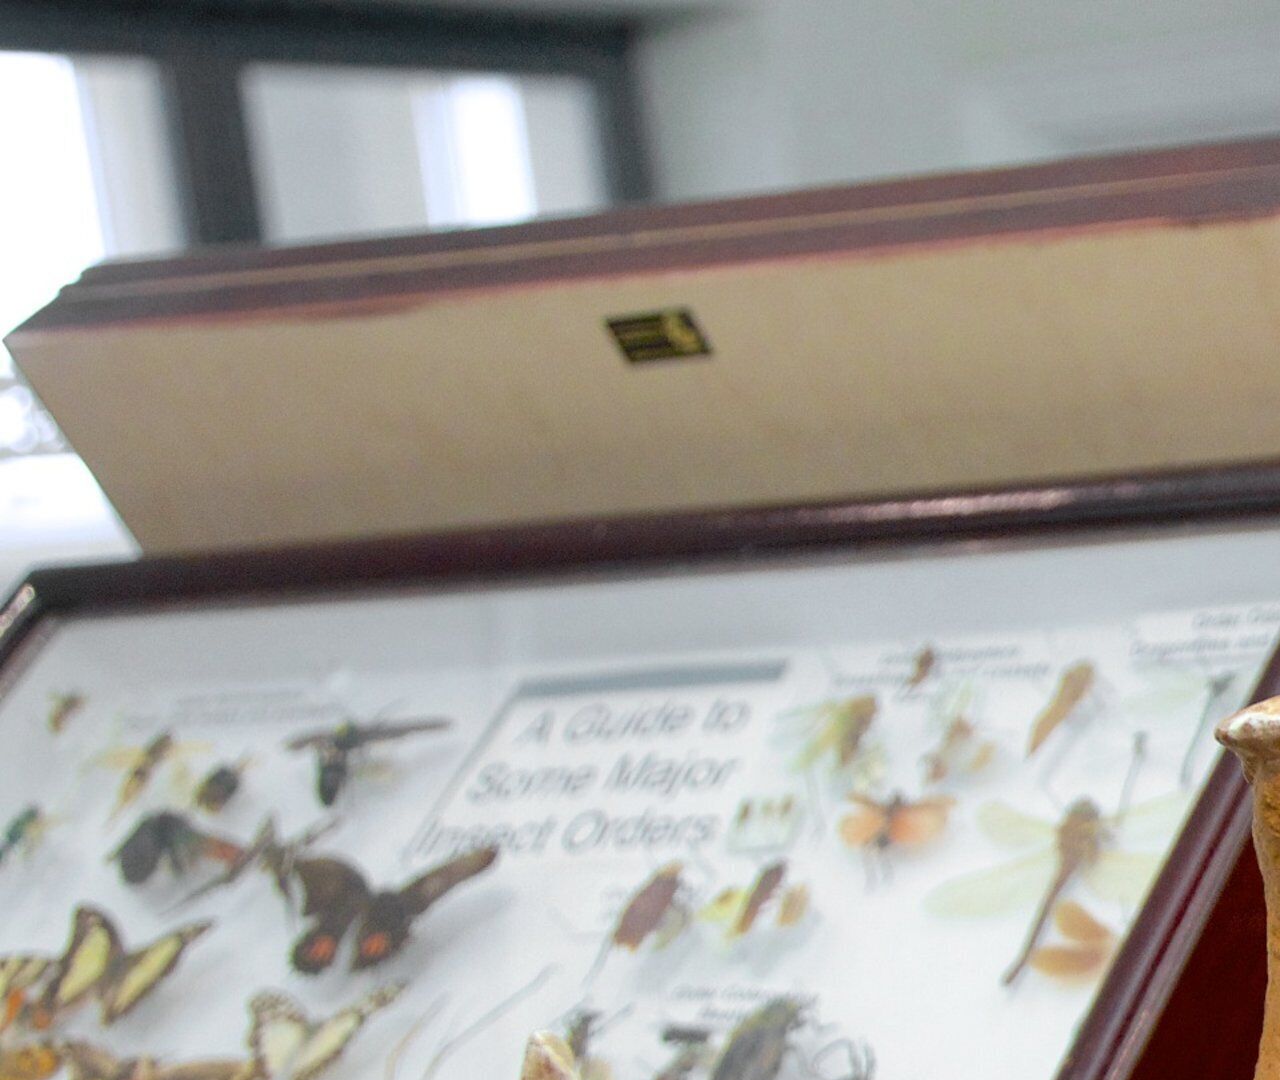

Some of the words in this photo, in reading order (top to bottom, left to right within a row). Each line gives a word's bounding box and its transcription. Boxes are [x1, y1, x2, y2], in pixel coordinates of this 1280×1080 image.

[513, 708, 555, 744] A
[562, 701, 695, 743] Guide
[702, 698, 751, 731] to
[466, 762, 597, 801] Some
[602, 751, 739, 796] Major
[415, 813, 560, 857] Insect
[561, 808, 722, 852] Orders
